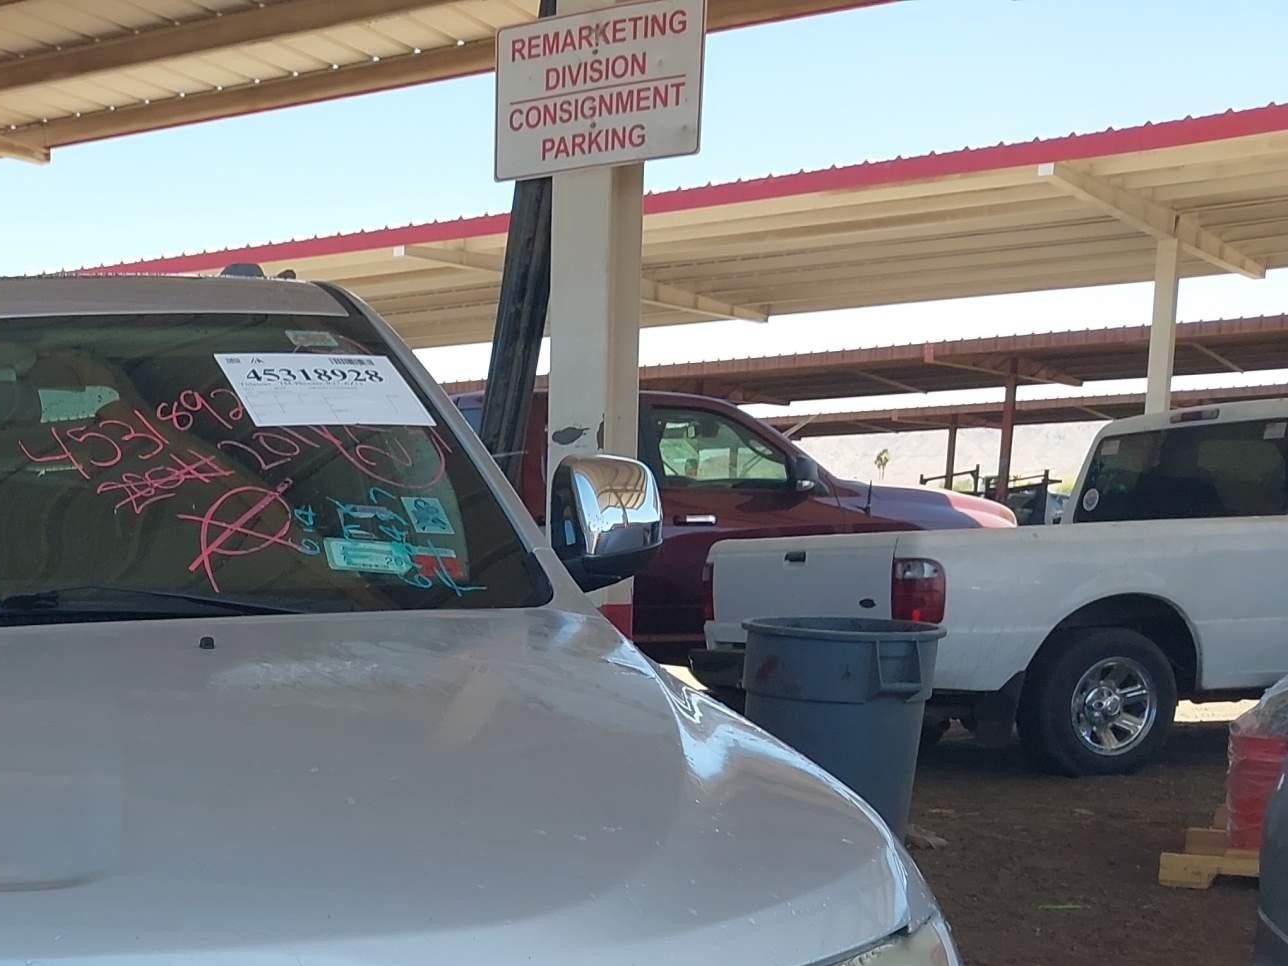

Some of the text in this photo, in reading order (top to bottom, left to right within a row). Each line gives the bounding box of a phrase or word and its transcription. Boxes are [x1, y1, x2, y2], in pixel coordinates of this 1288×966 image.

[511, 9, 688, 63] REMARKETING
[544, 51, 647, 91] DIVISION
[509, 81, 686, 132] CONSIGNMENT
[540, 123, 646, 161] PARKING
[246, 367, 384, 383] 45318928
